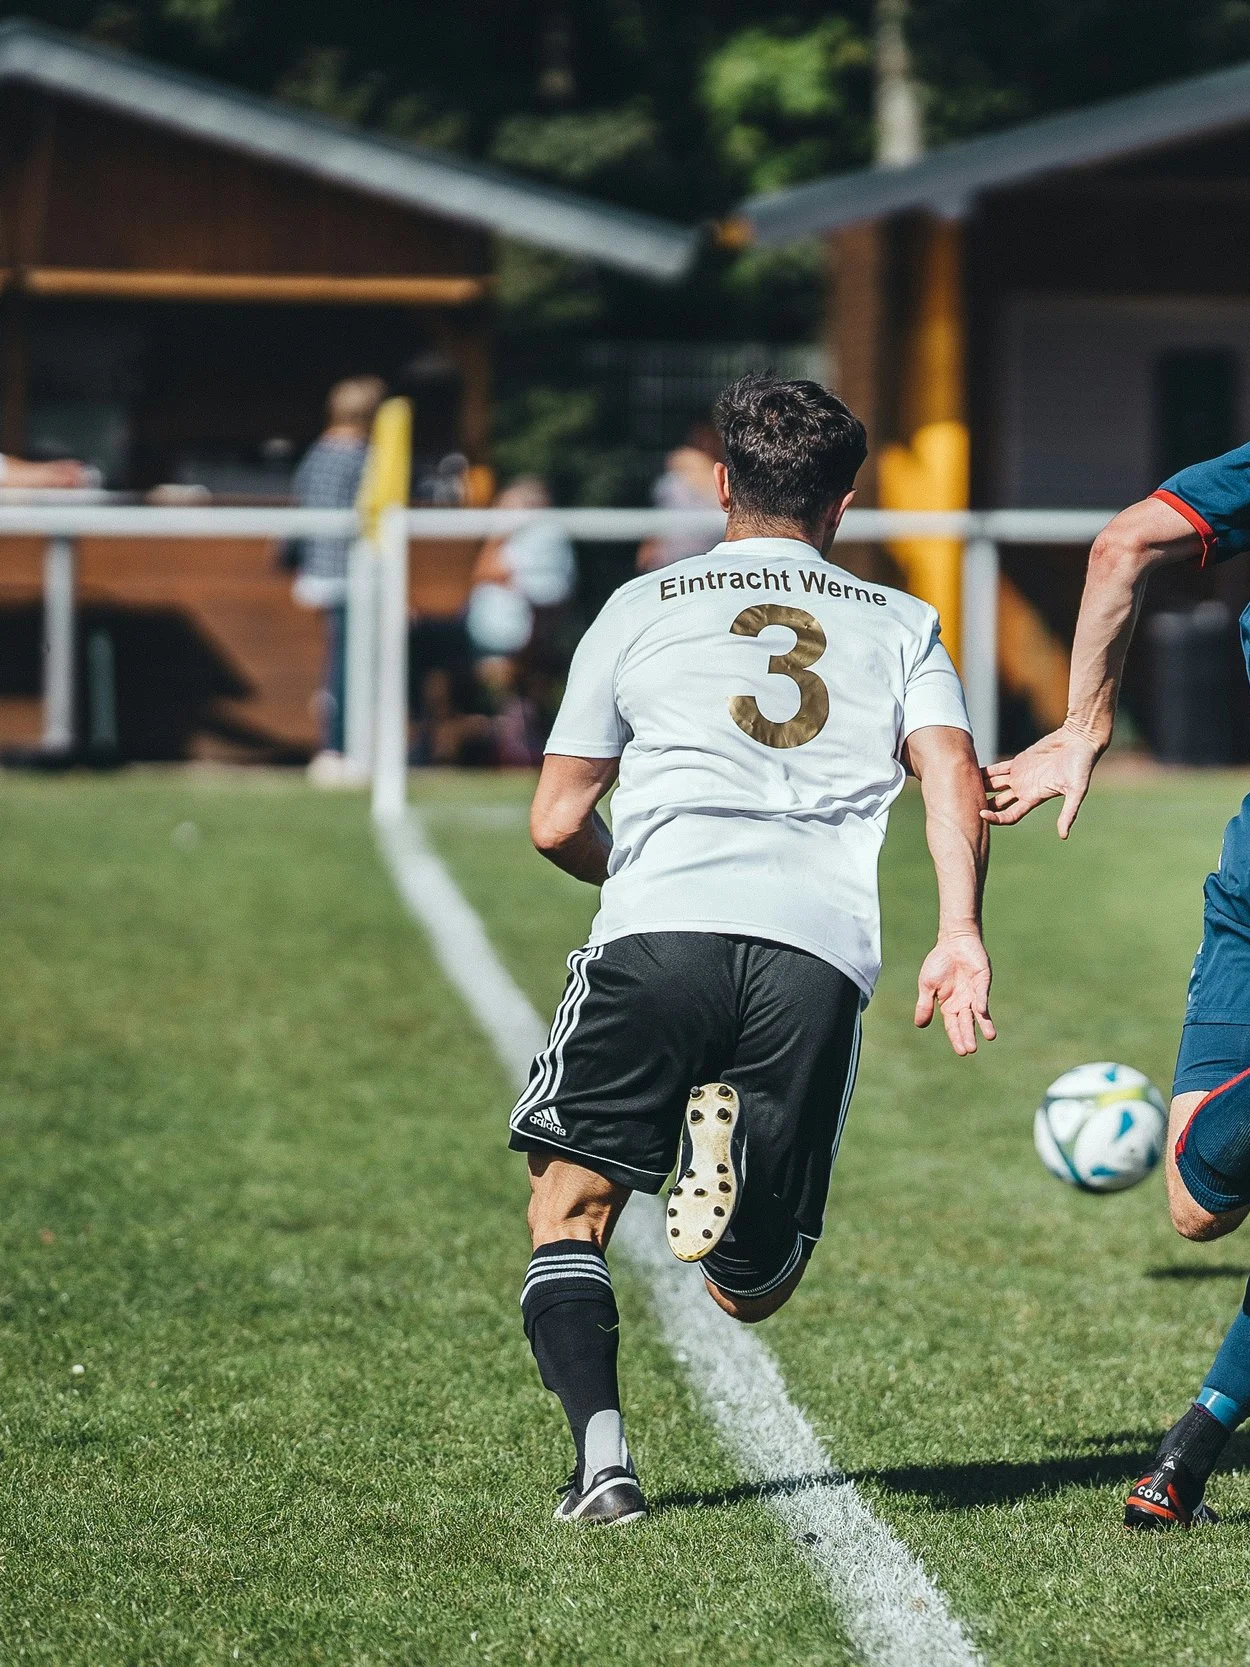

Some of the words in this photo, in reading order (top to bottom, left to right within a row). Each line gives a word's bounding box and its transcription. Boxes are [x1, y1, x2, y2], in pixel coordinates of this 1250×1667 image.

[660, 568, 791, 601] Eintracht
[798, 569, 887, 606] Werne
[729, 604, 829, 748] 3
[529, 1116, 567, 1136] adidas
[1138, 1486, 1169, 1507] COPA
